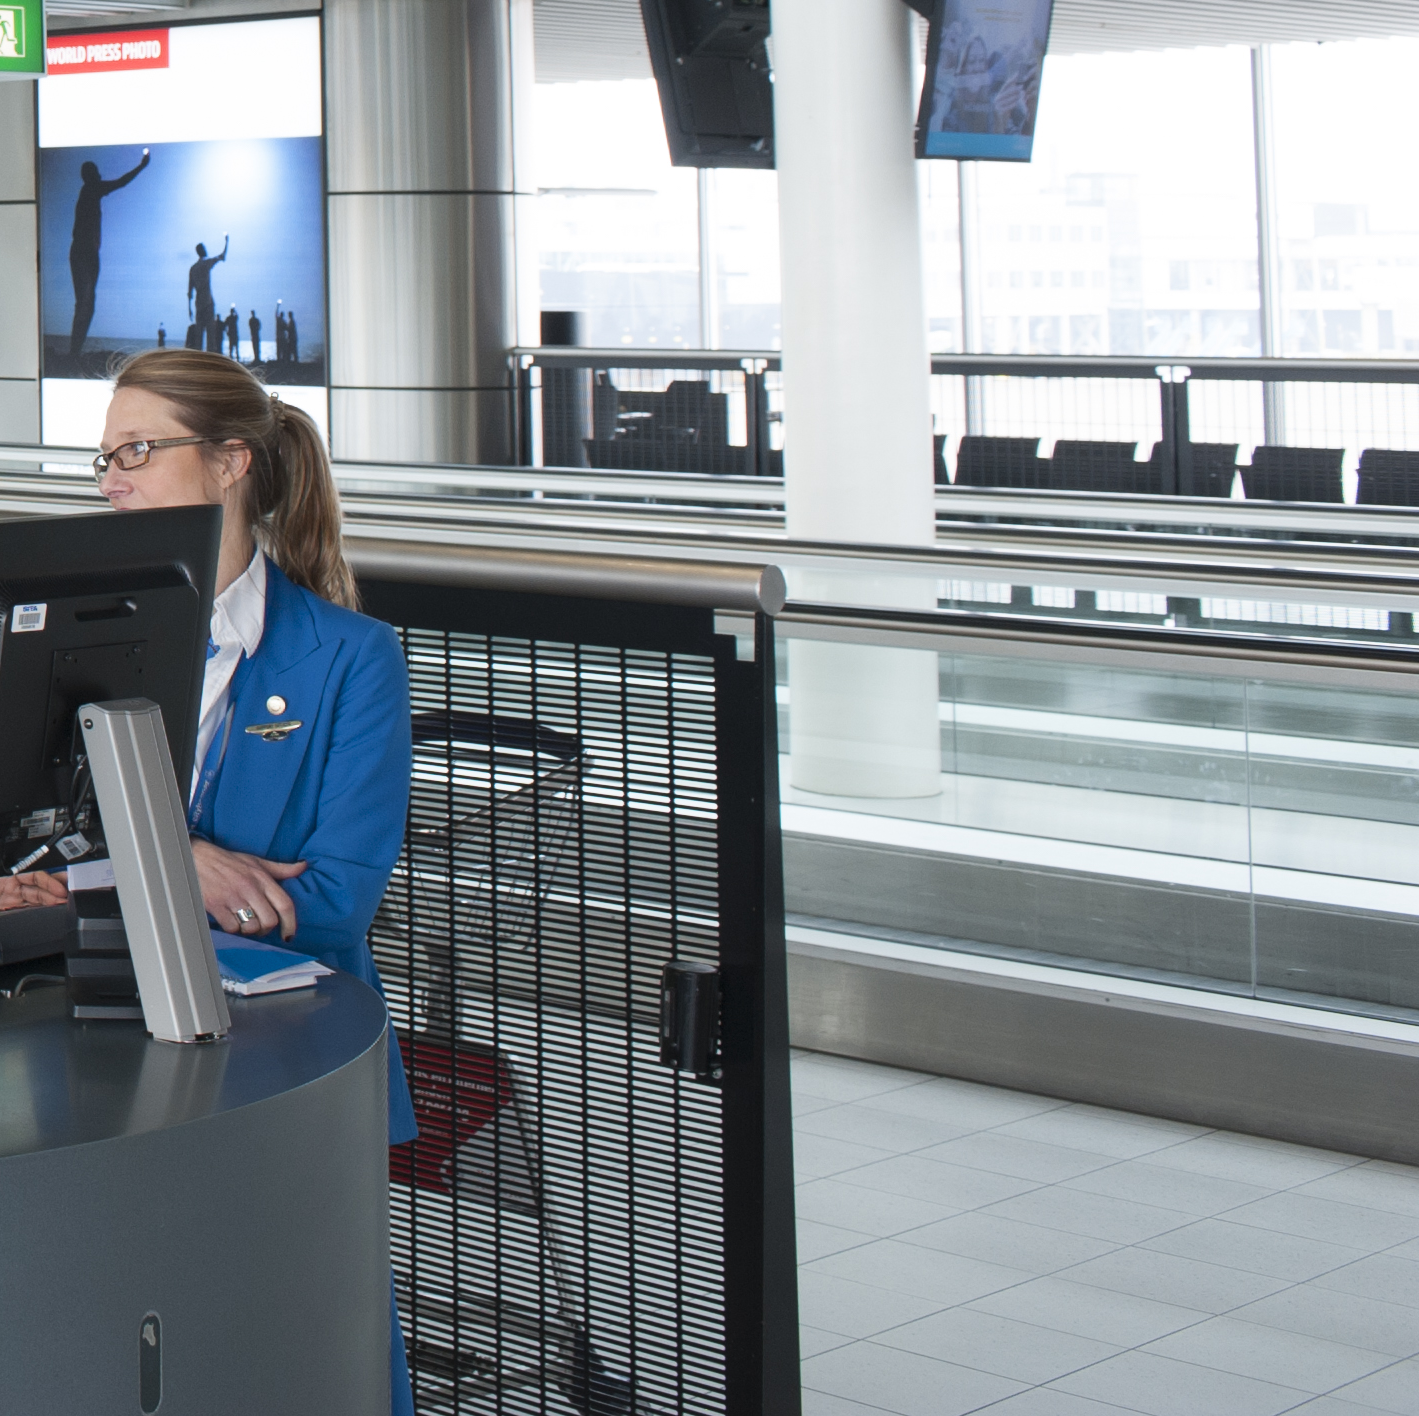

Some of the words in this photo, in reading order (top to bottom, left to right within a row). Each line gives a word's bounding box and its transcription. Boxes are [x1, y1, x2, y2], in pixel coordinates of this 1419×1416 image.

[47, 46, 85, 65] WORLD
[86, 42, 121, 63] PRESS
[123, 40, 161, 60] PHOTO
